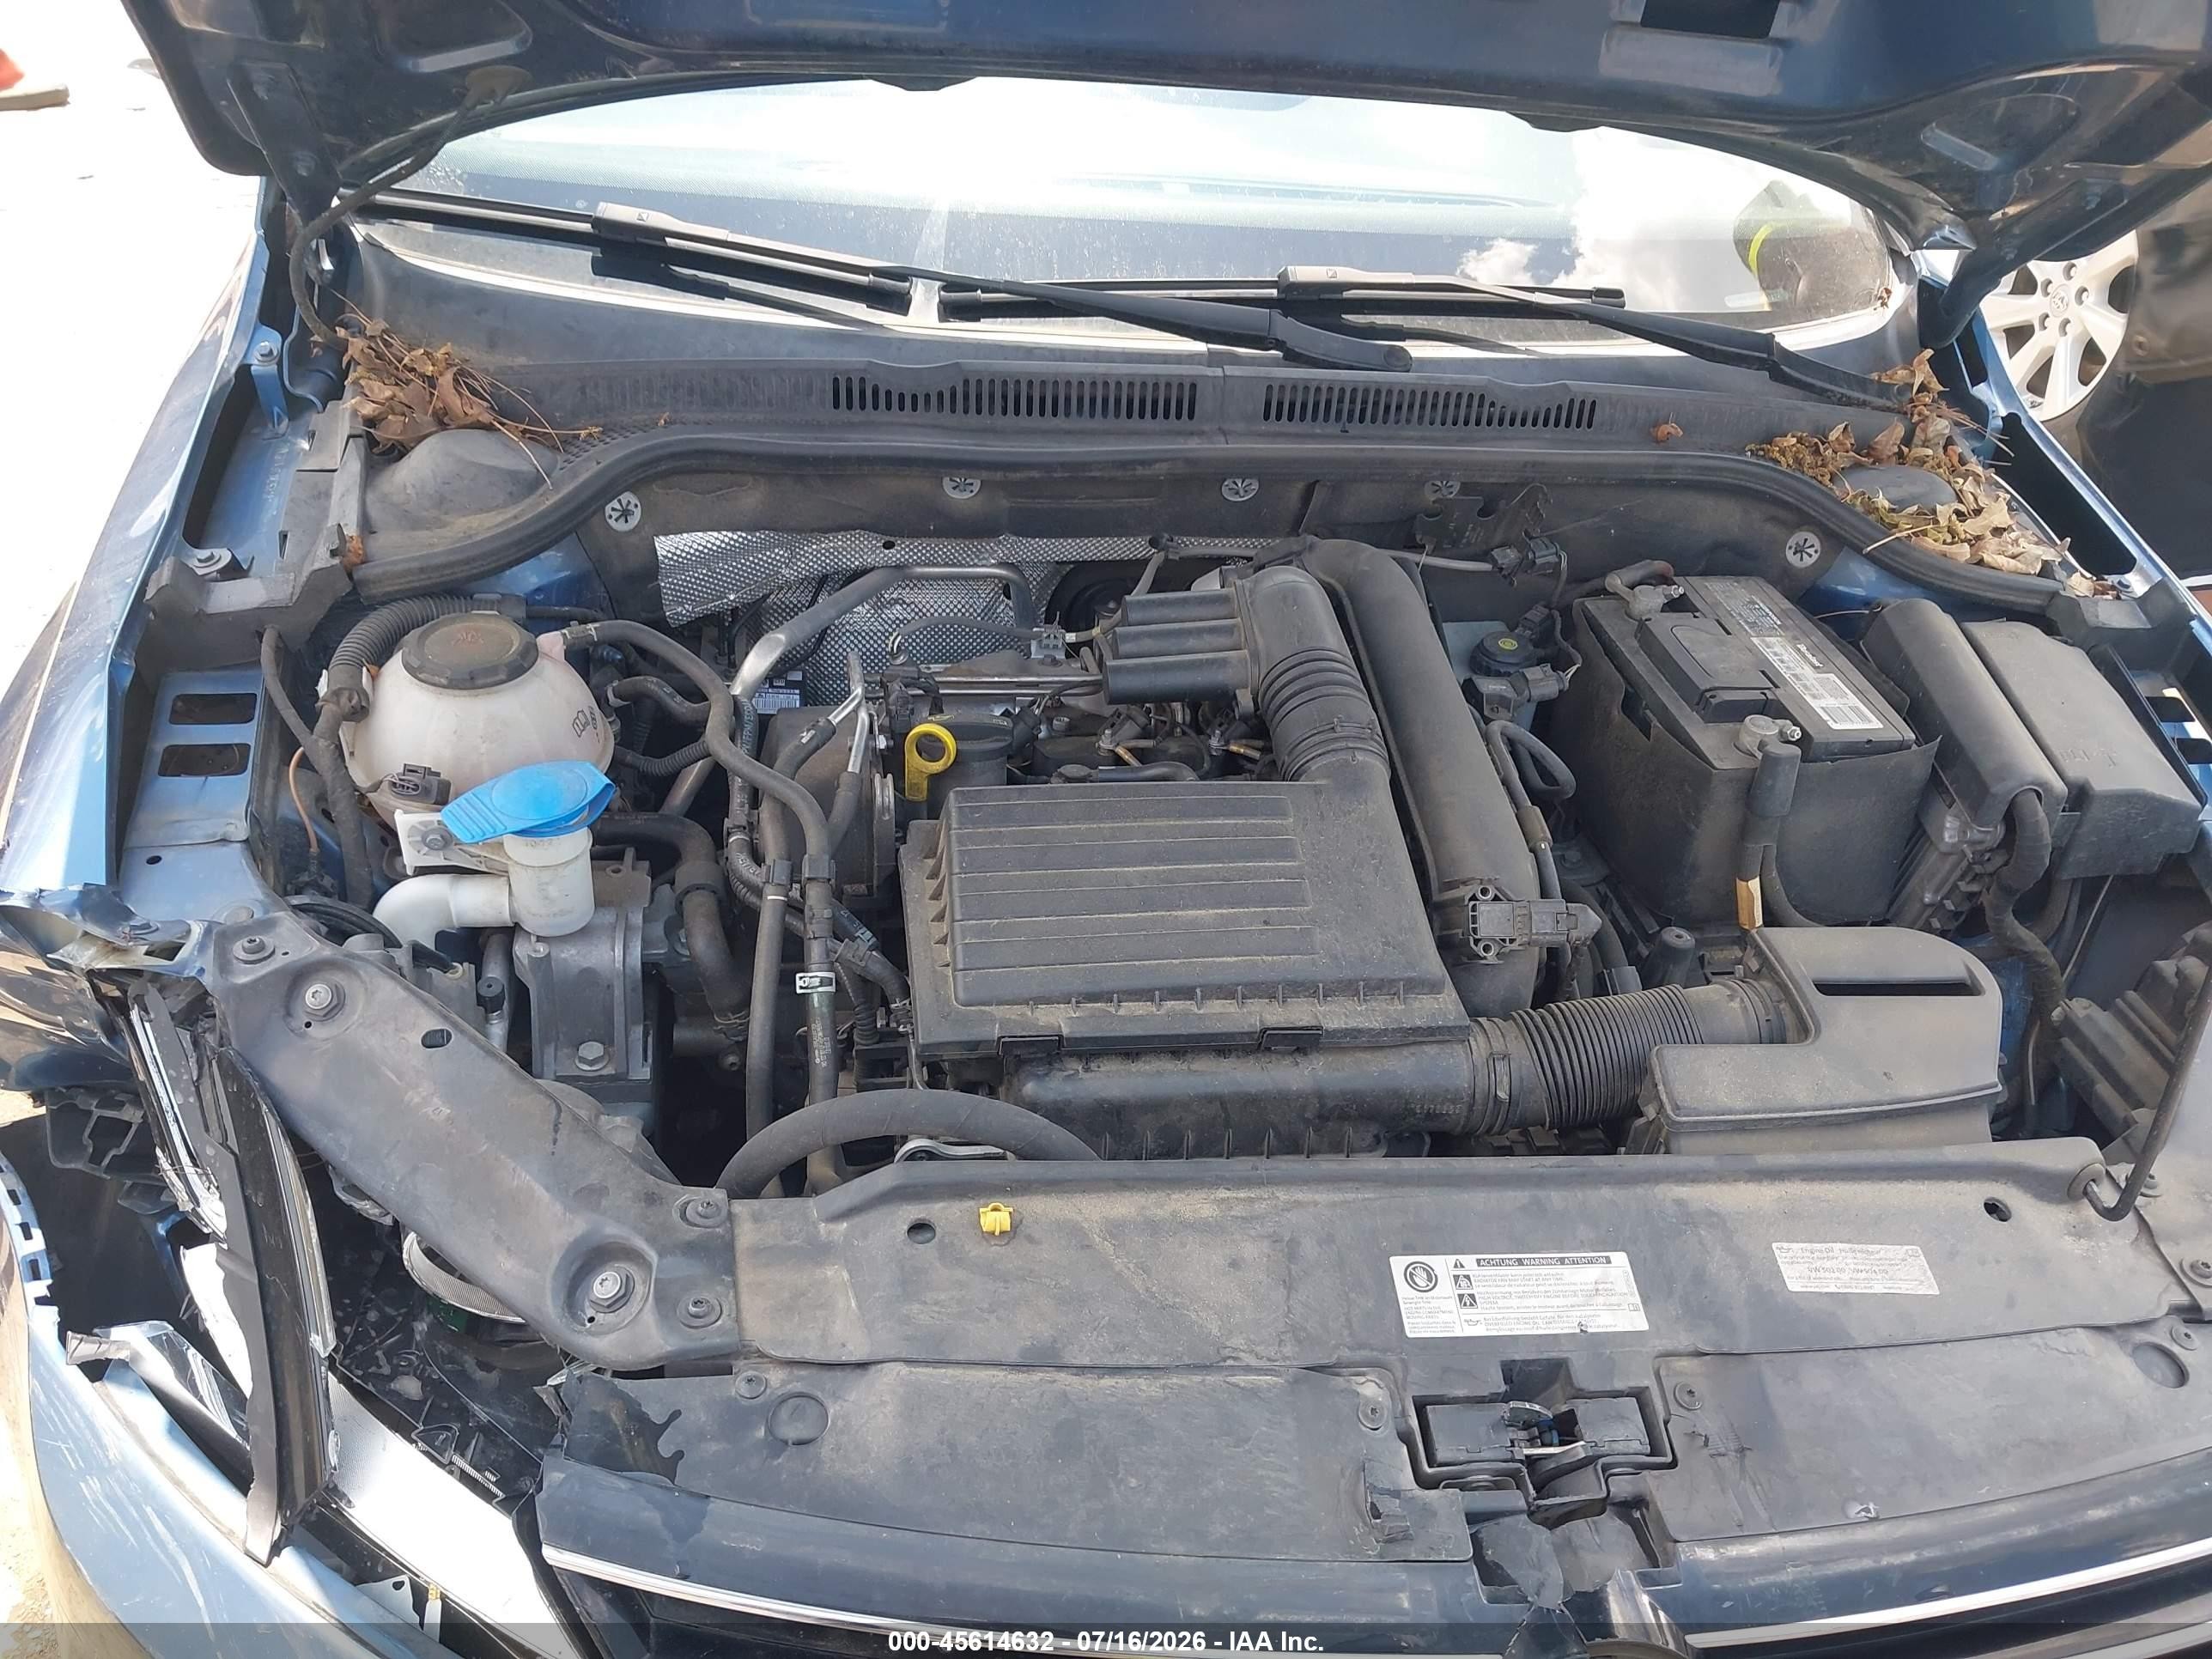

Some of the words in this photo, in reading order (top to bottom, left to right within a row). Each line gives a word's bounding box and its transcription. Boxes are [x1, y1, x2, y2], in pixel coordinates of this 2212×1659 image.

[1479, 1258, 1519, 1267] ACHTUNG
[1522, 1257, 1561, 1266] WARNING
[1564, 1256, 1607, 1265] ATTENTION
